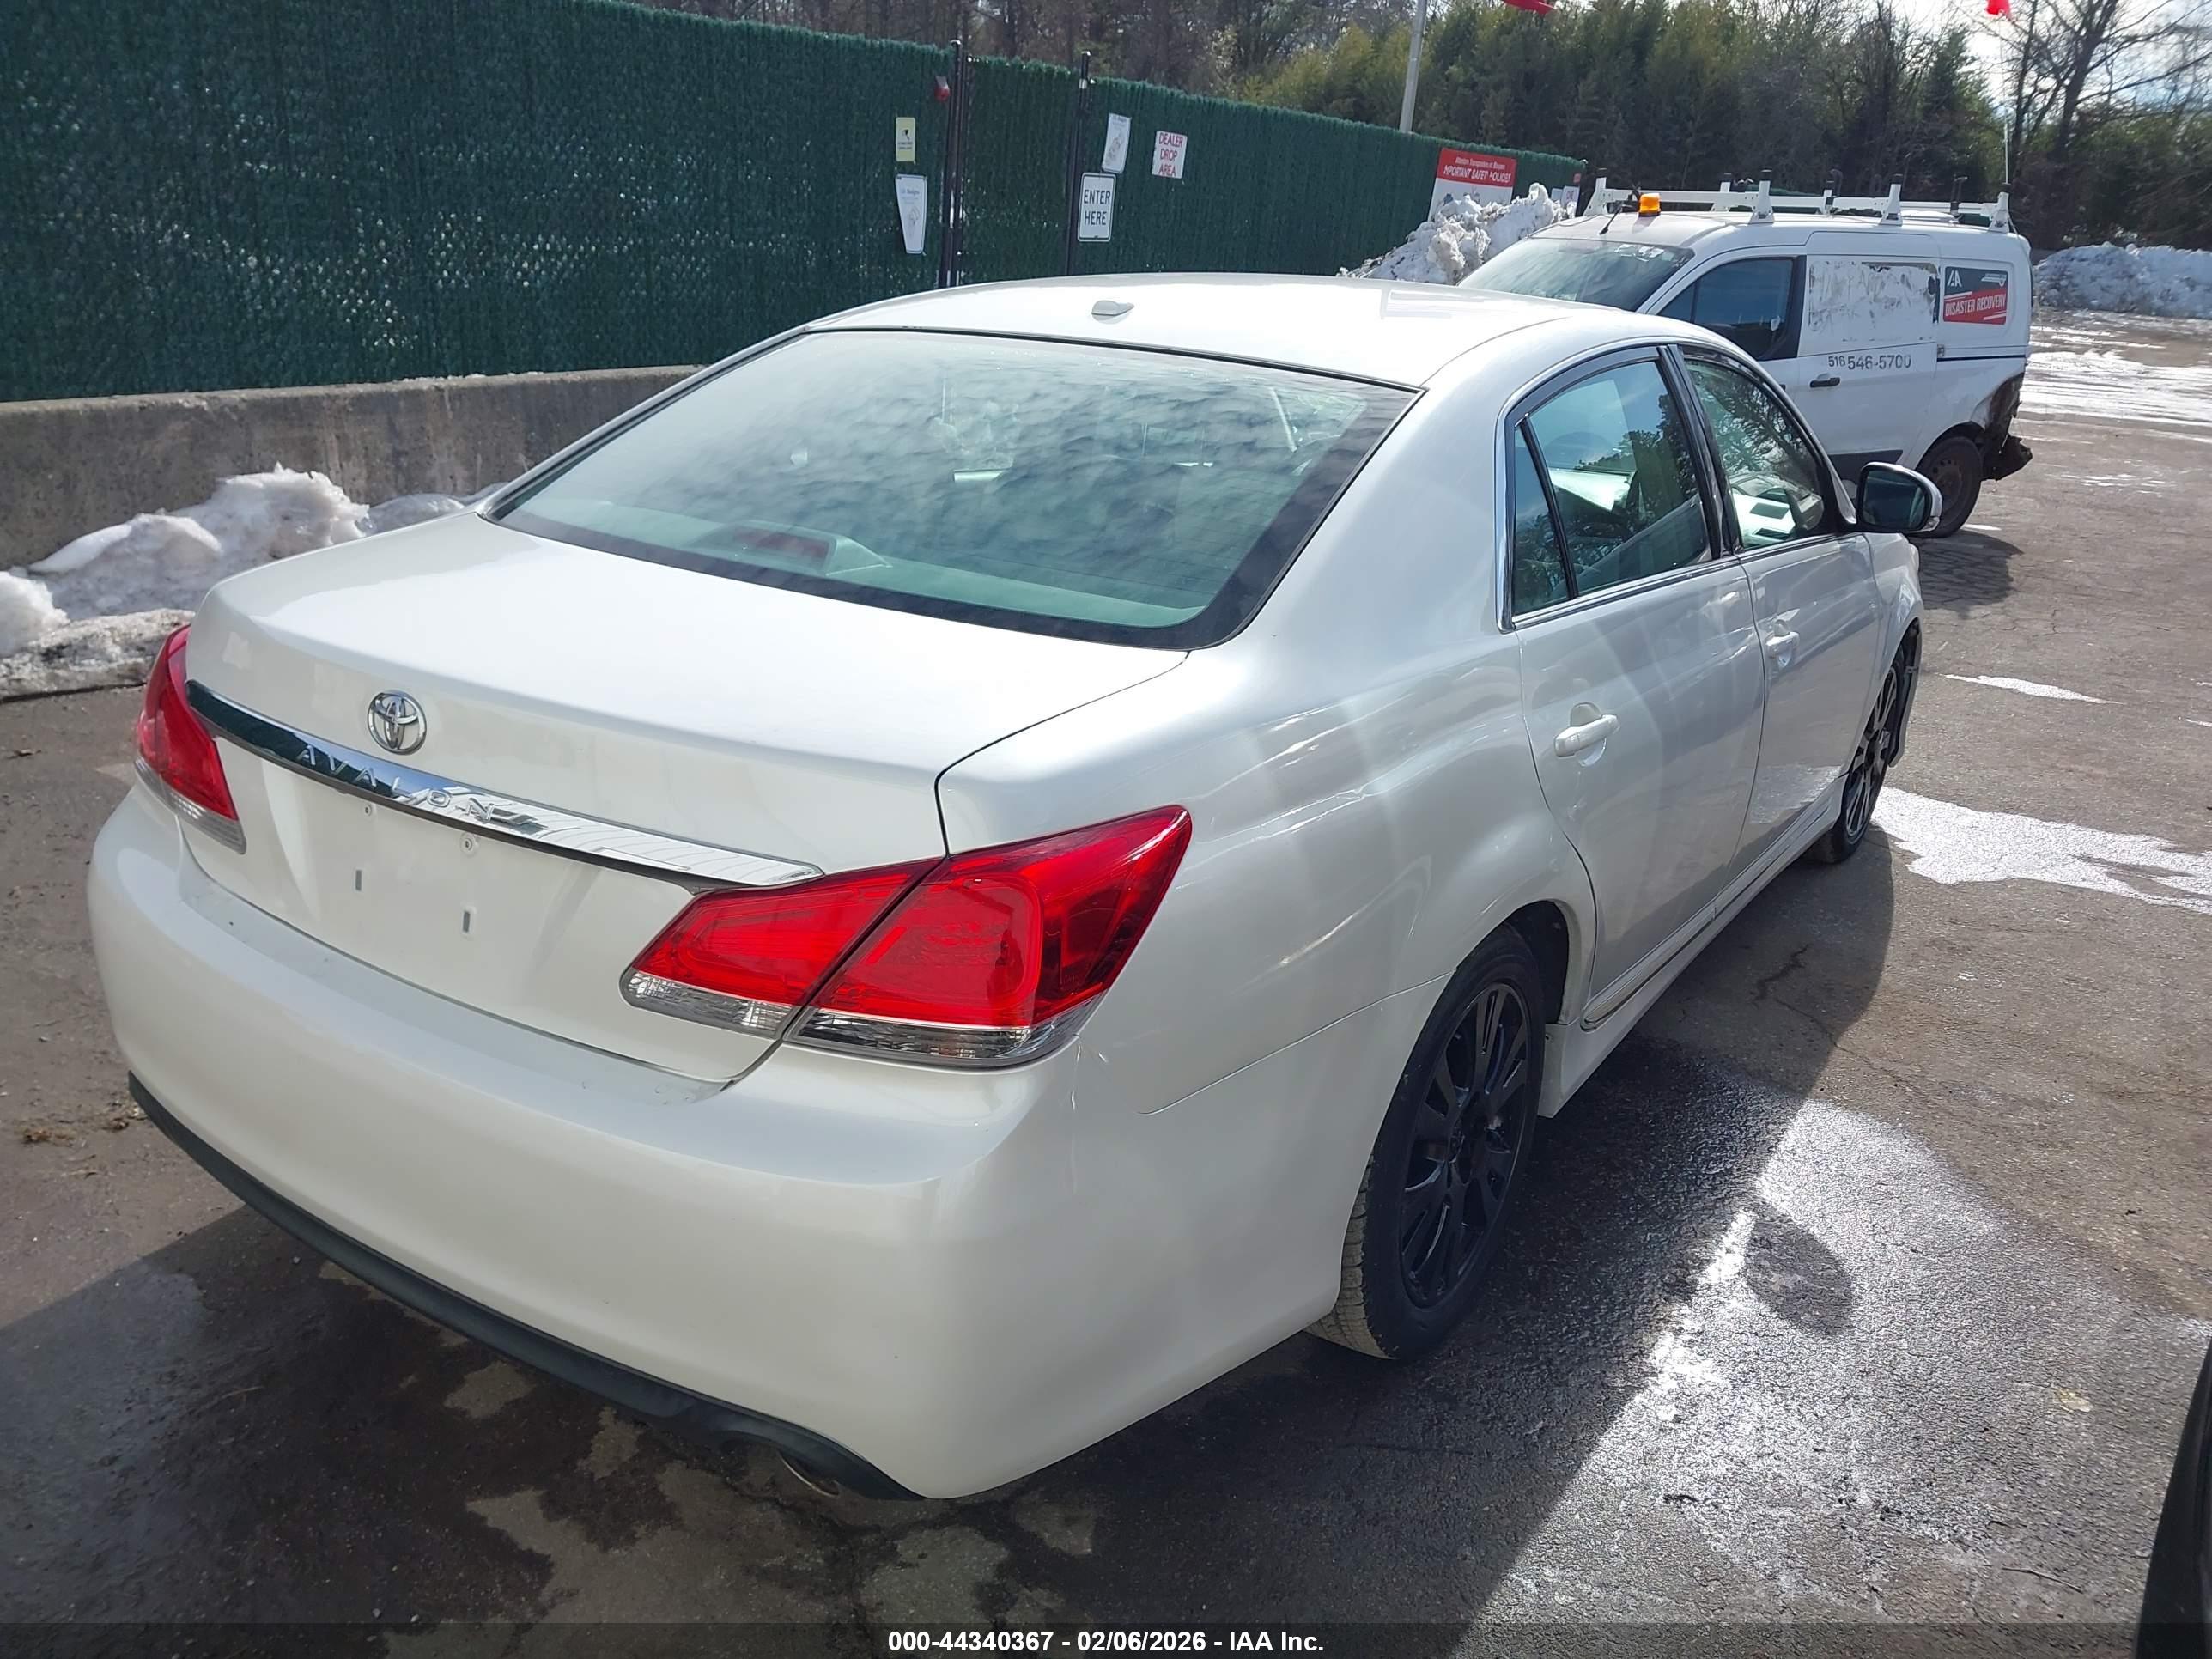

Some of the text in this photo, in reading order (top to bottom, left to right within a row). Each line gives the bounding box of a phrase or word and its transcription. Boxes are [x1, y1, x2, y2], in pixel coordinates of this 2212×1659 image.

[1158, 132, 1183, 148] DEALER
[1160, 149, 1178, 161] DROP
[1158, 164, 1176, 177] AREA
[1083, 189, 1111, 204] ENTER
[1084, 210, 1108, 225] HERE
[1945, 294, 2007, 316] DISASTER RECOVERY
[1827, 354, 1911, 370] 516 546-5700
[297, 744, 495, 823] AVALON
